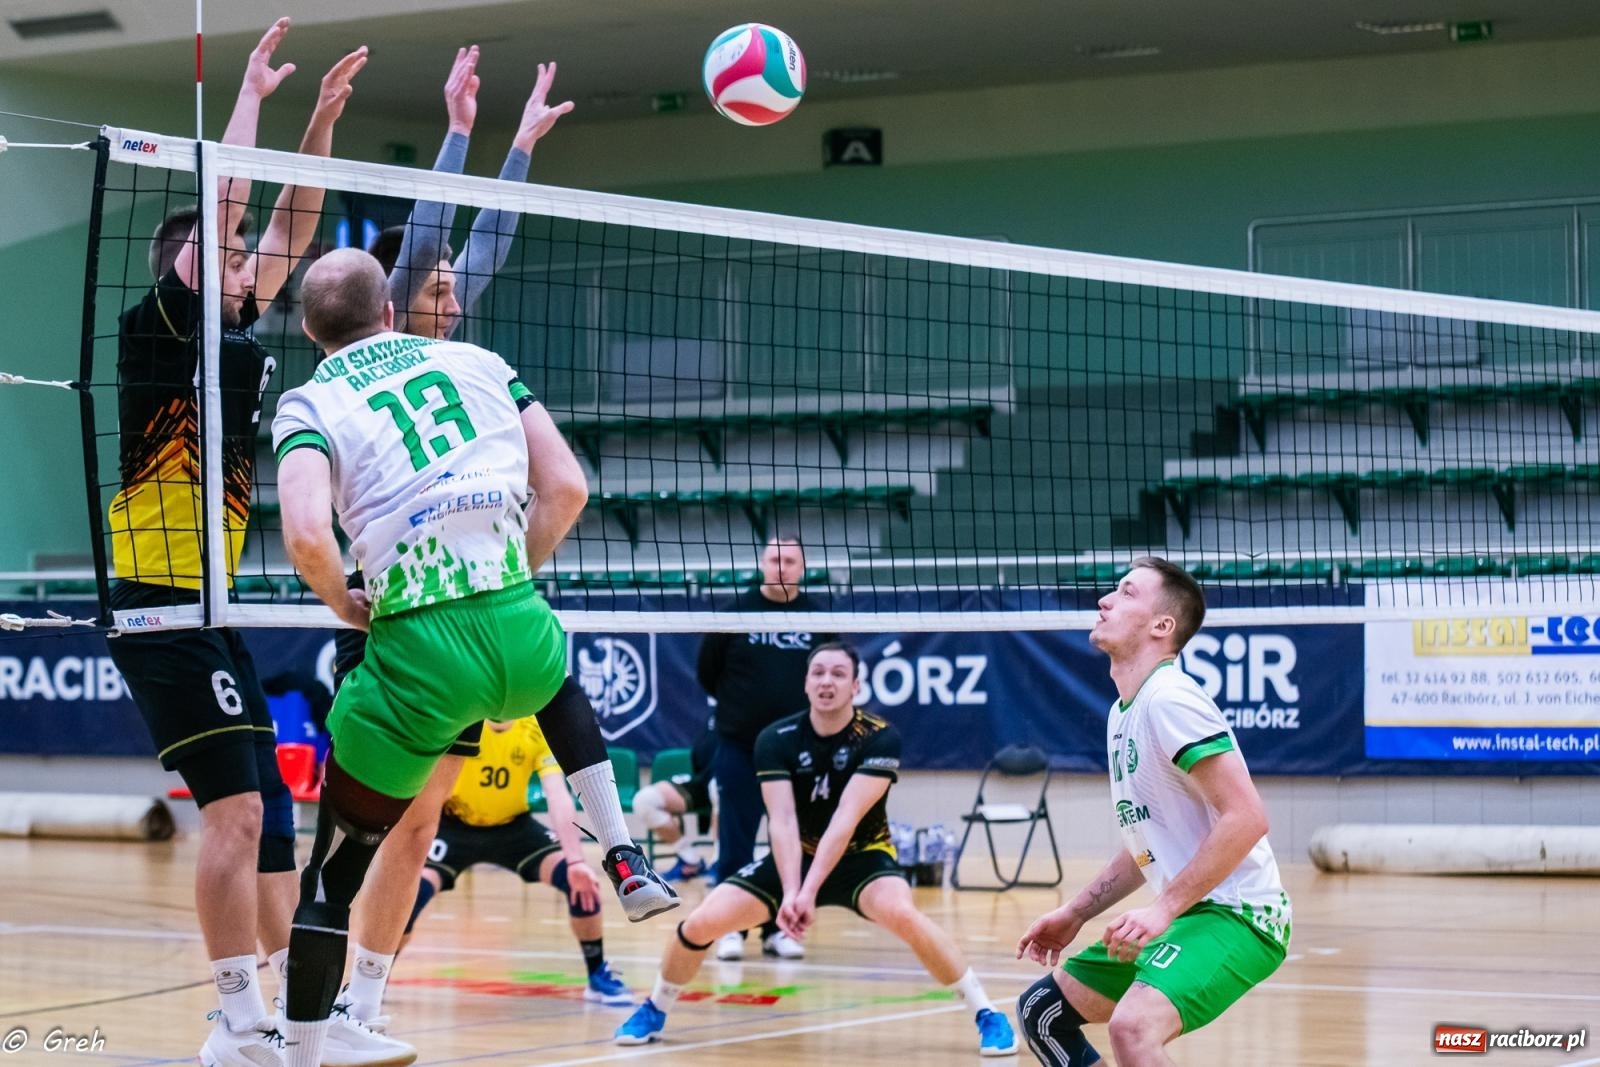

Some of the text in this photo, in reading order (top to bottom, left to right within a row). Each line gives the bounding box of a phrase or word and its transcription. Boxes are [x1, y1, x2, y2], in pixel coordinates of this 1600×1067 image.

[122, 139, 158, 154] netex
[841, 141, 873, 162] A
[366, 370, 478, 473] 13
[127, 615, 162, 628] netex
[0, 655, 134, 701] RACIB
[1177, 633, 1300, 703] SiR
[211, 670, 243, 716] 6
[1391, 691, 1438, 706] 47-400
[1536, 694, 1561, 705] von
[1452, 733, 1600, 755] www.instal-tech.pl
[480, 766, 510, 789] 30
